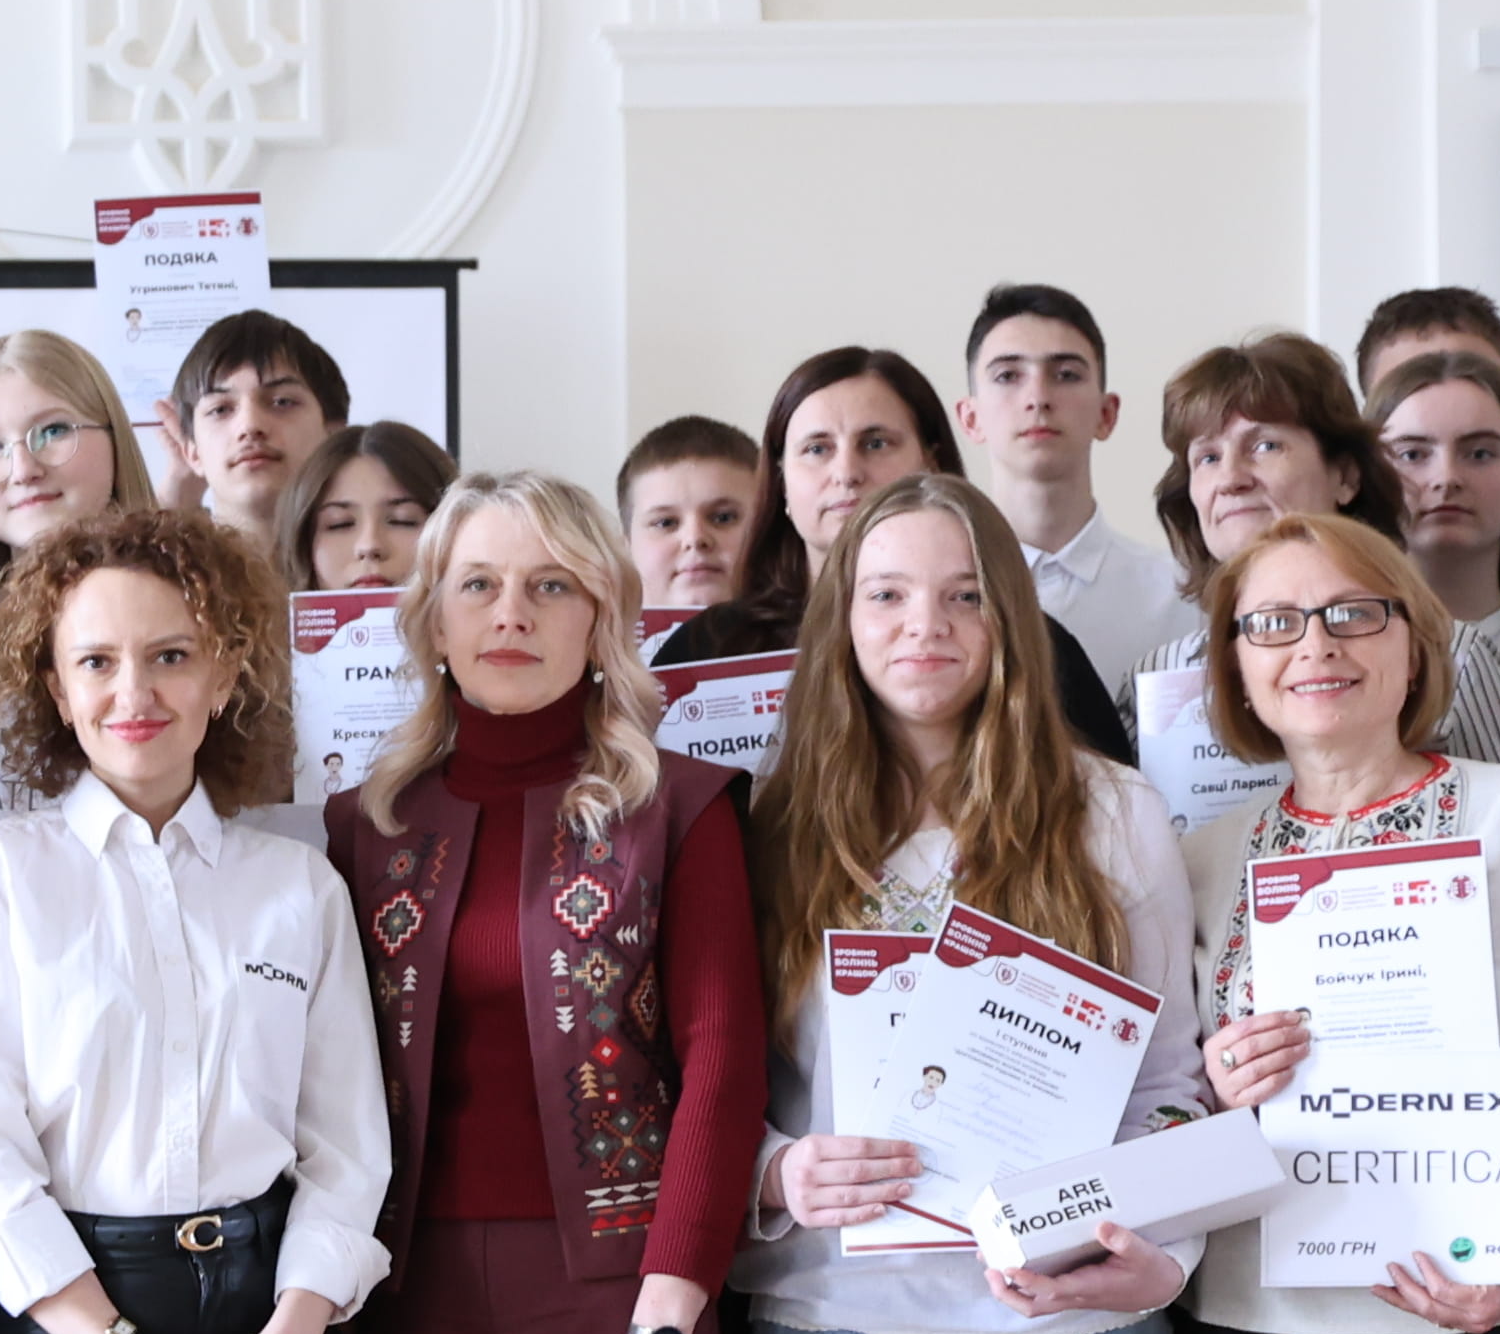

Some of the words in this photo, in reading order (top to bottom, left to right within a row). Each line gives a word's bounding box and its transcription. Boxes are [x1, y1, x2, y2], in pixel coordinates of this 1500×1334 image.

[145, 251, 218, 267] ПОДЯКА
[688, 733, 780, 758] ПОДЯКА
[1318, 925, 1420, 949] ПОДЯКА
[1315, 971, 1375, 986] Бойчук
[979, 999, 1082, 1055] ДИПЛОМ
[1001, 1032, 1049, 1059] ступеня
[1058, 1178, 1105, 1204] ARE
[1009, 1195, 1113, 1237] MODERN
[1296, 1241, 1336, 1256] 7000
[1340, 1241, 1377, 1256] ГРН
